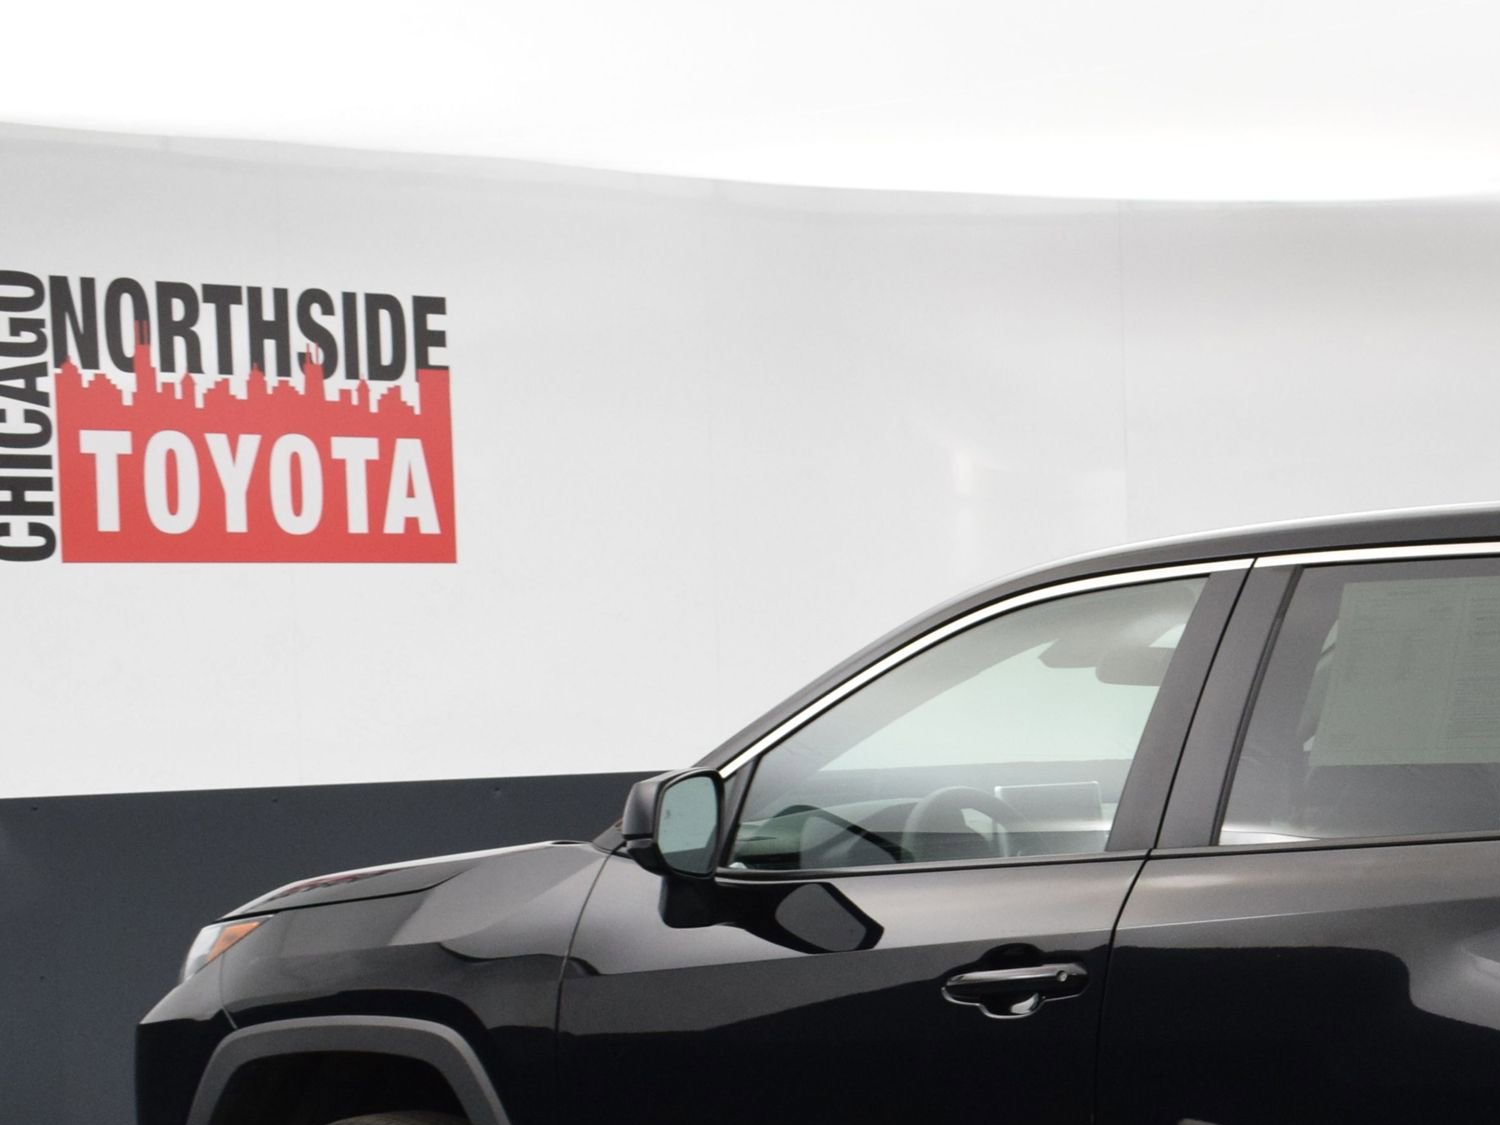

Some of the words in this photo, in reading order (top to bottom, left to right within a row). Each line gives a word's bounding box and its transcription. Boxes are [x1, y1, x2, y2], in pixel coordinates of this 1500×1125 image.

[49, 275, 449, 382] NORTHSIDE
[0, 270, 56, 562] CHICAGO
[79, 429, 441, 535] TOYOTA
